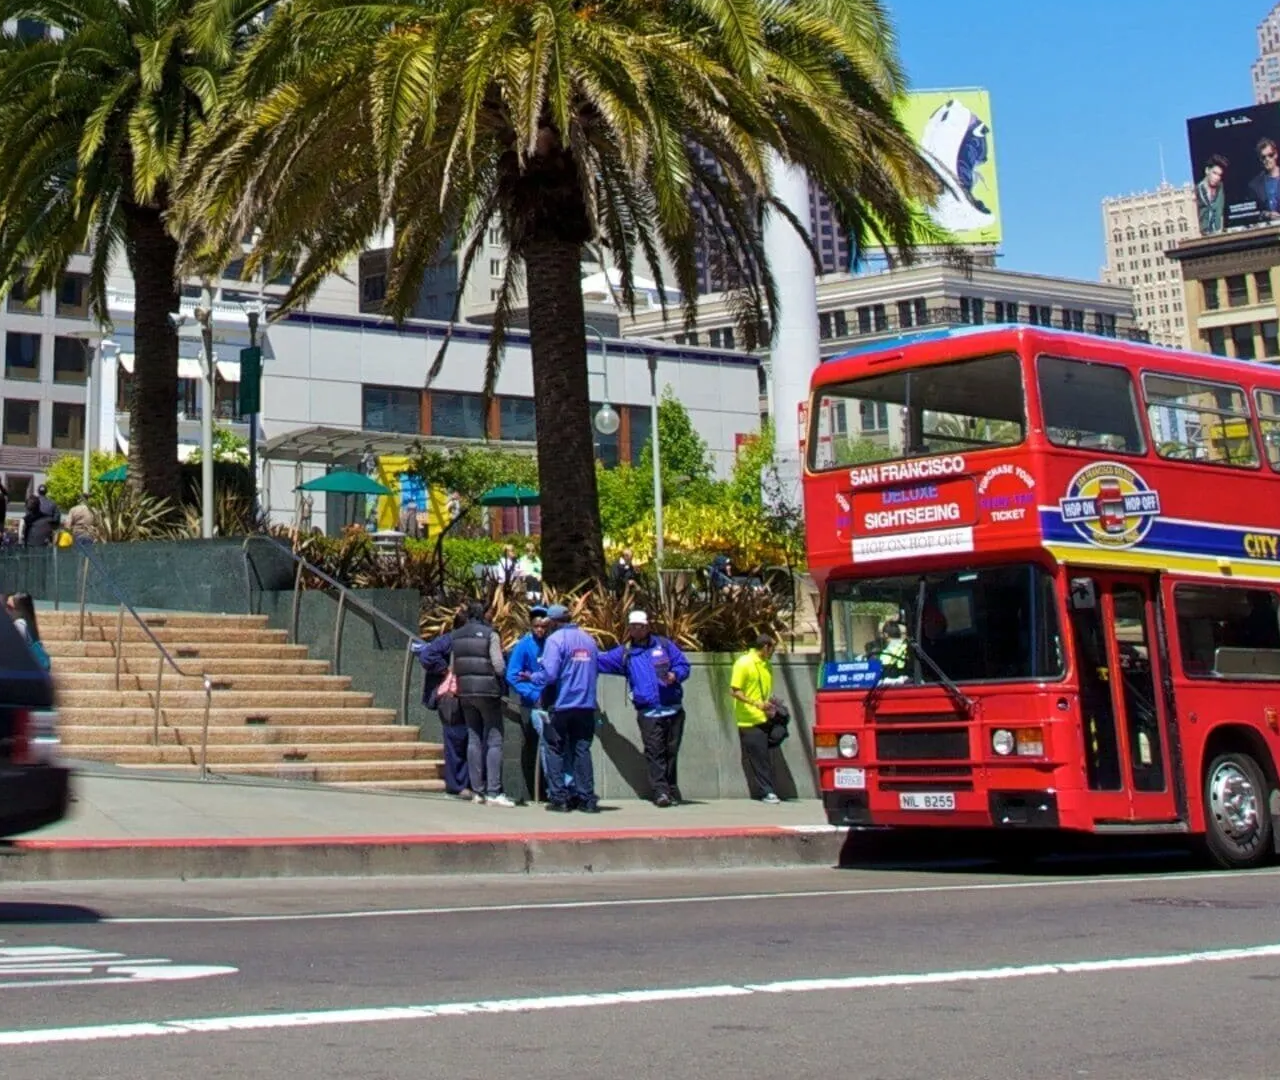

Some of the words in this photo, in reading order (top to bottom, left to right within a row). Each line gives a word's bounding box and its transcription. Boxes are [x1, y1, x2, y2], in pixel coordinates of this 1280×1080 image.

[850, 468, 879, 487] SAN
[881, 456, 965, 482] FRANCISCO
[978, 463, 1014, 494] PURCHASE
[1015, 466, 1036, 489] YOUR
[882, 484, 938, 504] DELUXE
[1124, 497, 1141, 512] HOP
[1141, 495, 1157, 509] OFF
[864, 502, 960, 530] SIGHTSEEING
[990, 508, 1026, 522] TICKET
[1063, 502, 1082, 518] HOP
[1082, 501, 1096, 516] ON
[860, 541, 886, 555] HOP
[909, 534, 935, 550] HOP
[1243, 533, 1279, 560] CITY
[902, 796, 920, 808] NIL
